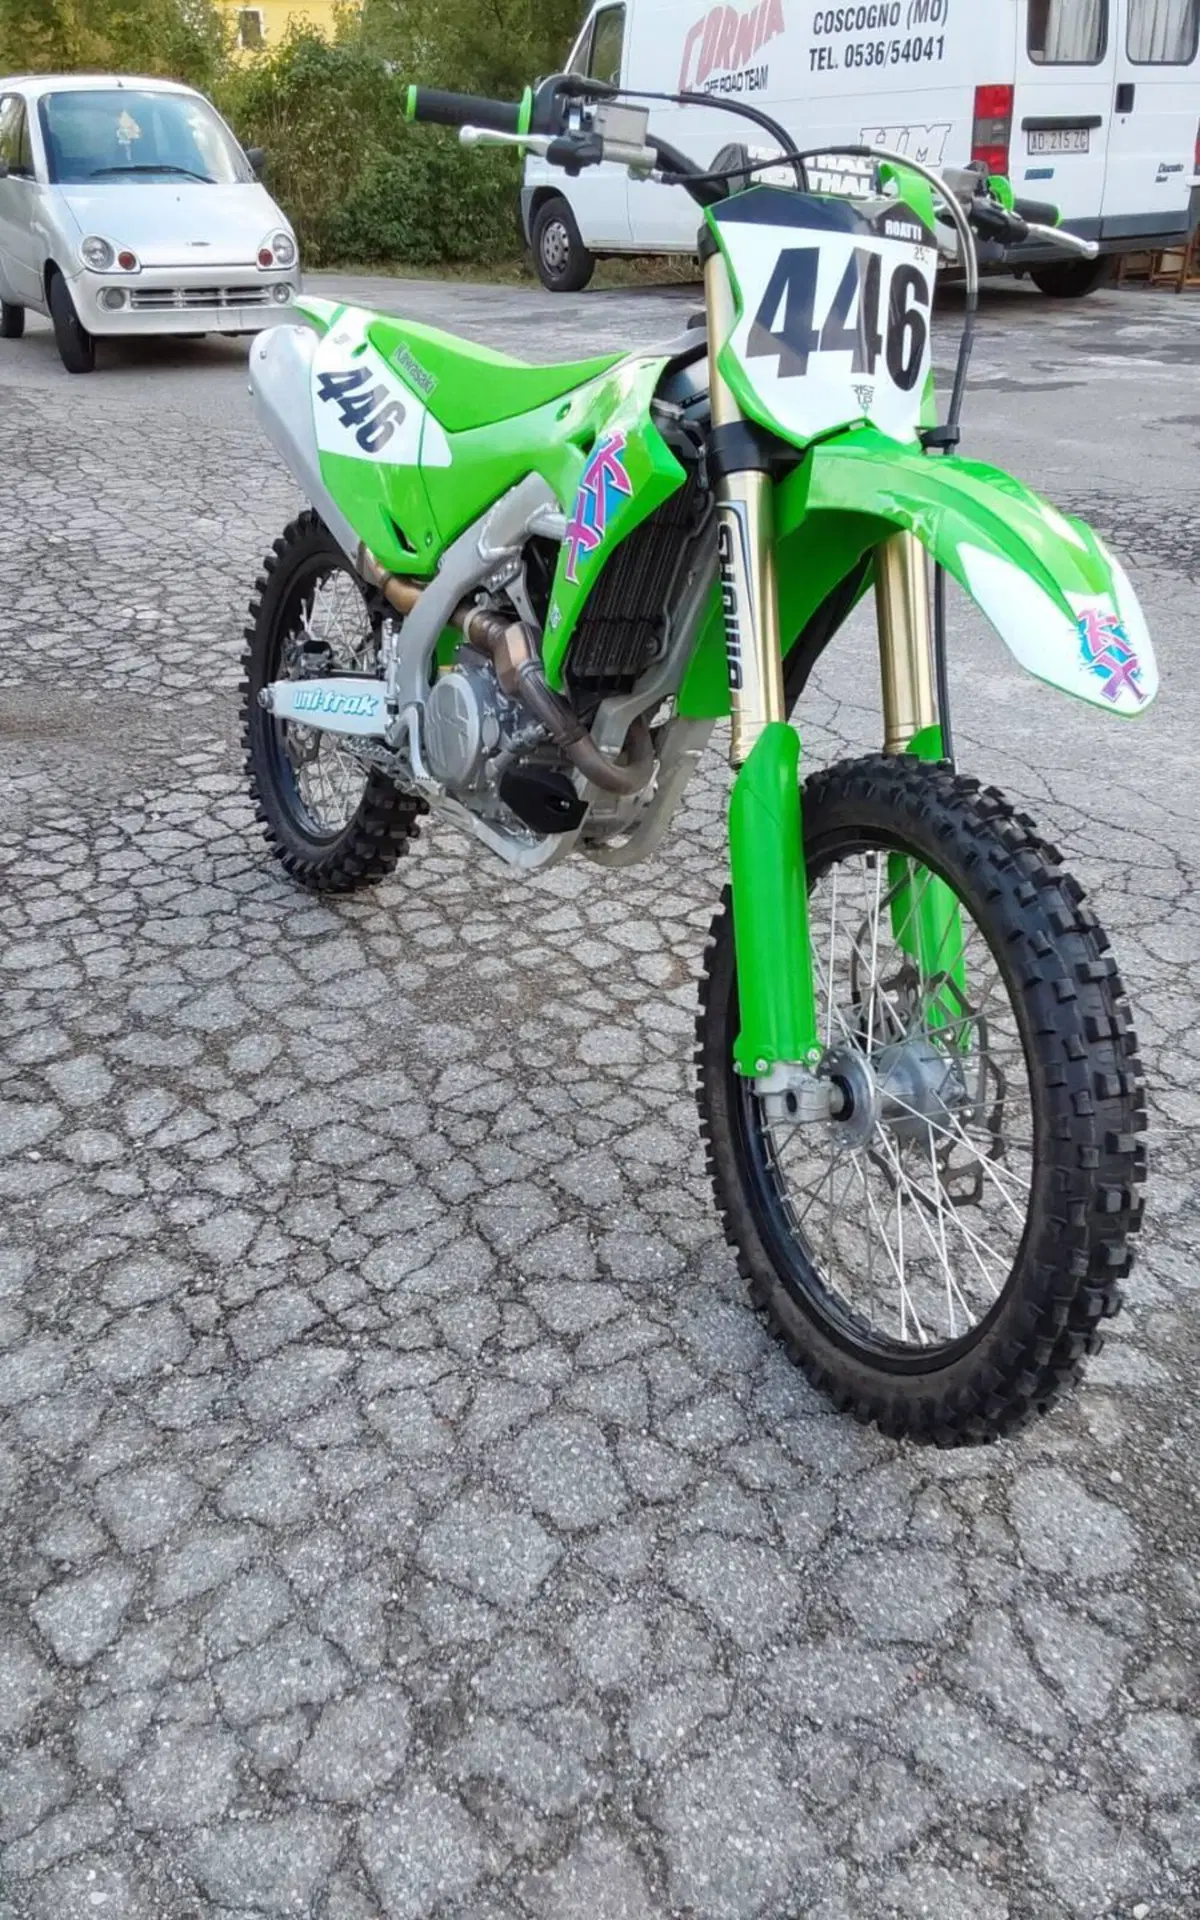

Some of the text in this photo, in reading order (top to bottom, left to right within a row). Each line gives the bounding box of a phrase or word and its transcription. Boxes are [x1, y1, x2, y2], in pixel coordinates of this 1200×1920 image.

[813, 0, 949, 35] COSCOGNO (MO)
[809, 35, 944, 71] TEL. 0536/54041
[720, 72, 743, 93] ROAD
[744, 64, 769, 91] TEAM
[745, 246, 930, 392] 446
[393, 342, 439, 396] Kawasaki
[317, 366, 406, 453] 446
